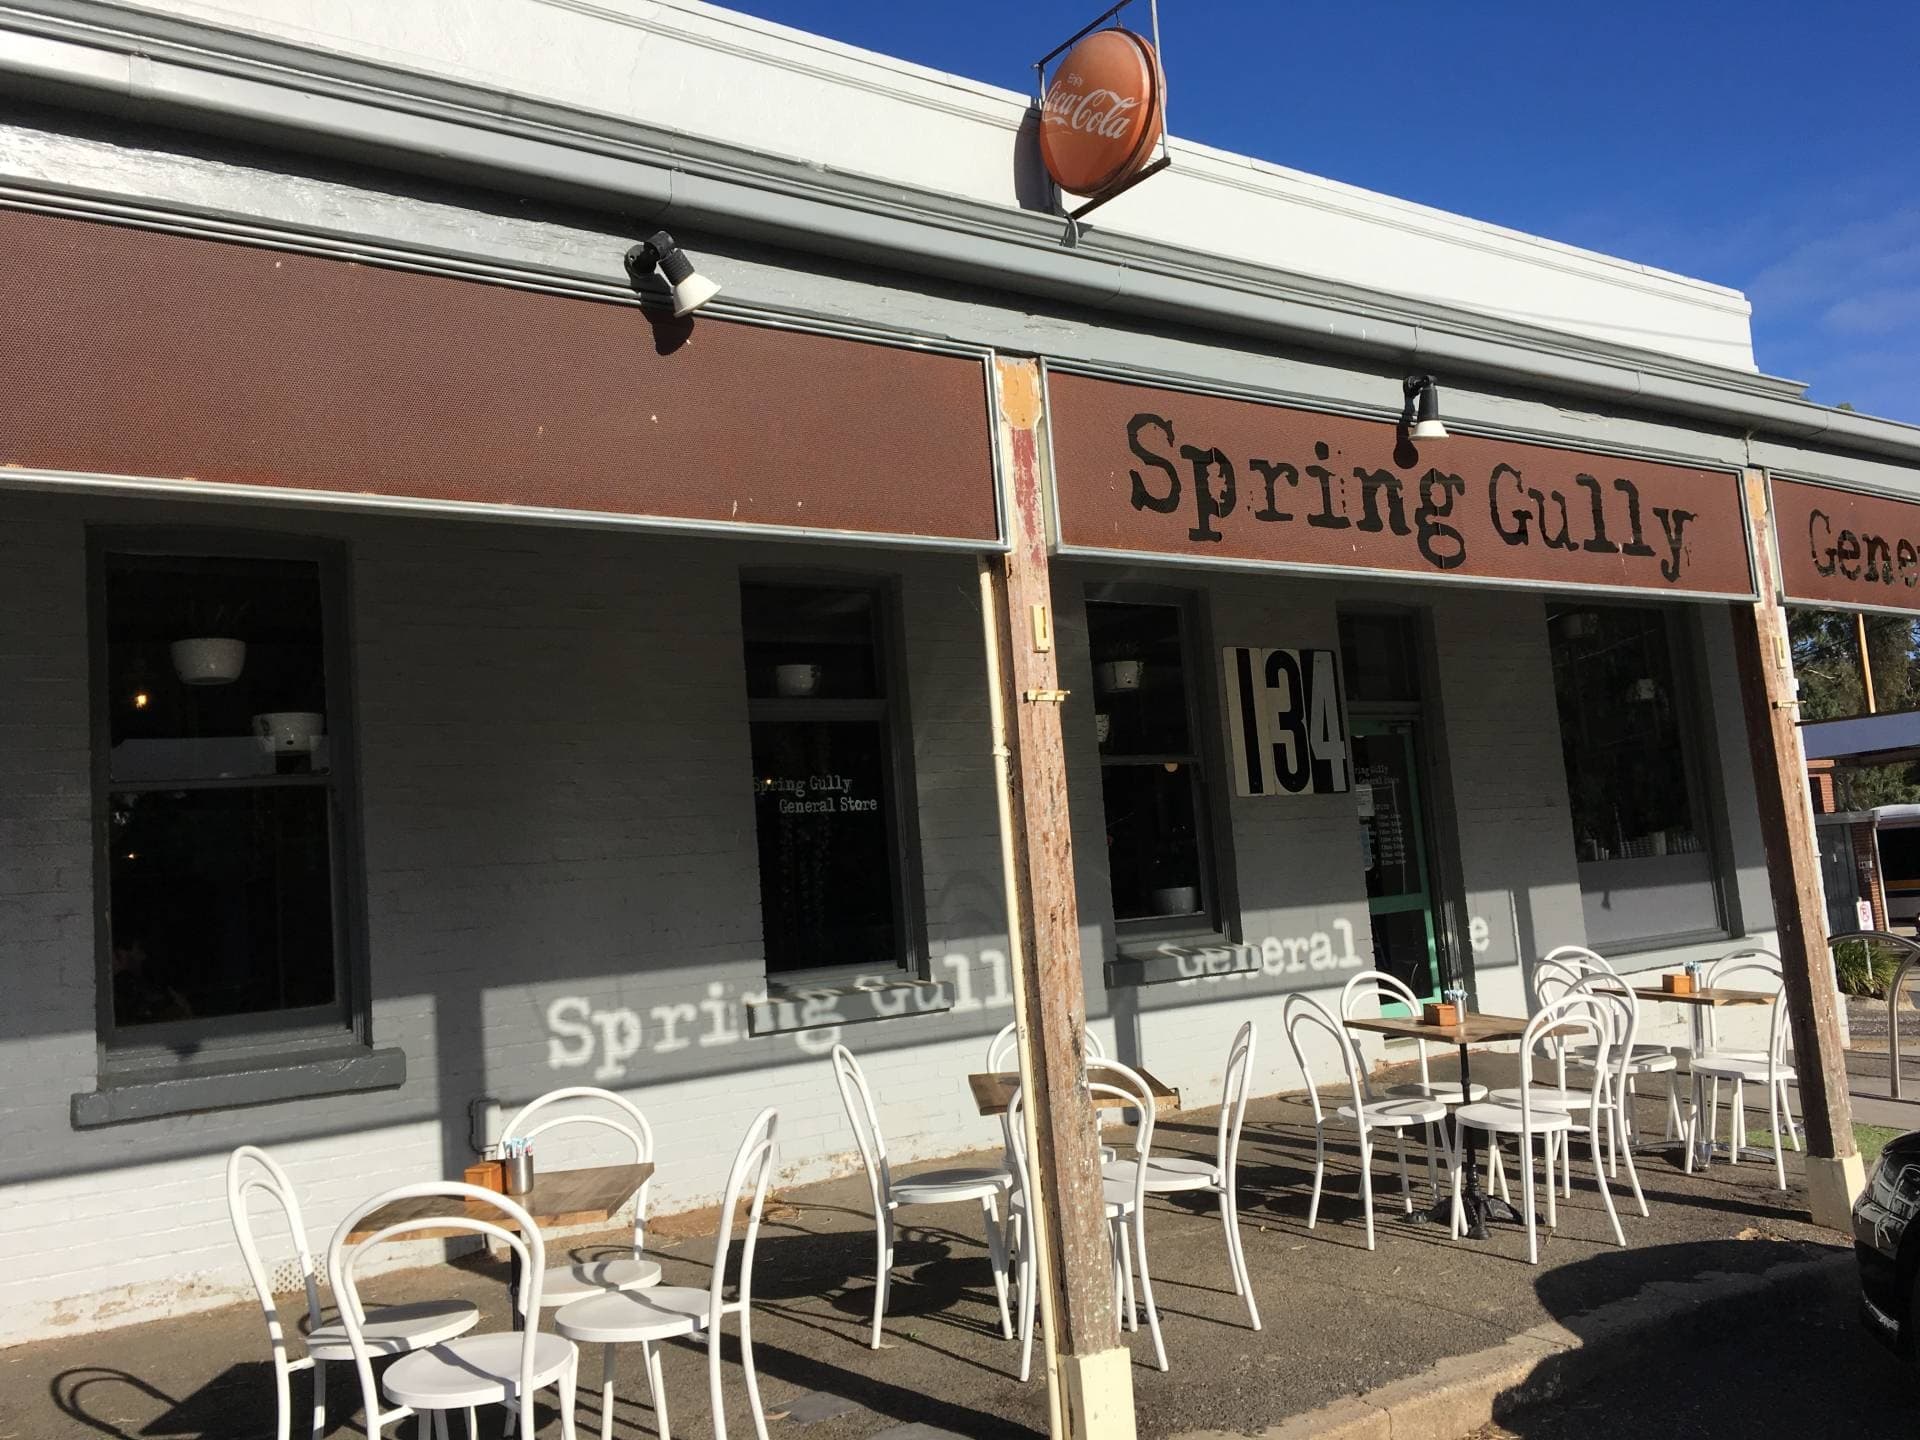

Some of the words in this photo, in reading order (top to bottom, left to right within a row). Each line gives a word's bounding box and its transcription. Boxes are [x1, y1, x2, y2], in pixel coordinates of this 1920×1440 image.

[1126, 413, 1466, 570] Spring
[1488, 463, 1698, 582] Gully
[1809, 508, 1920, 587] Gene
[1236, 650, 1349, 794] 134
[779, 798, 836, 814] General
[840, 797, 878, 812] Store
[810, 775, 853, 793] Gully
